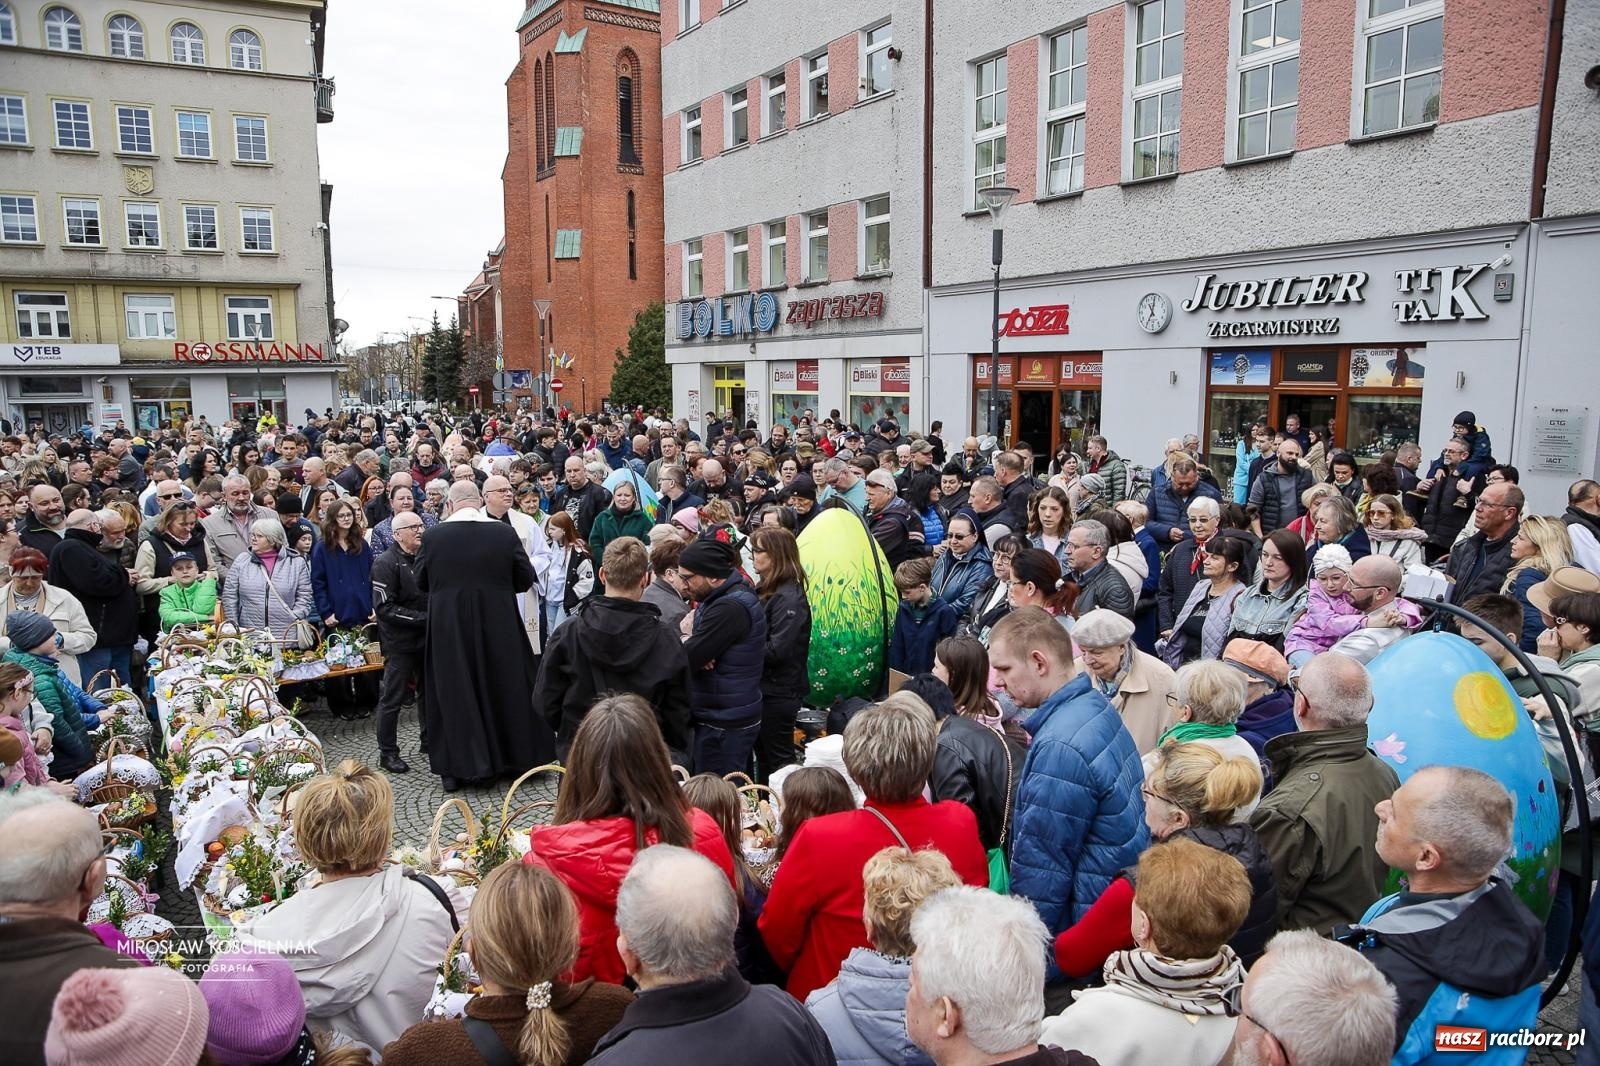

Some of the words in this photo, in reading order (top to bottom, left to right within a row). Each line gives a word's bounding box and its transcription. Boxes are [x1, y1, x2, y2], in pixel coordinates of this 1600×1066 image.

[1181, 271, 1369, 312] JUBILER
[676, 292, 779, 340] BOLKO
[786, 291, 884, 329] zaprasza
[1206, 317, 1340, 337] ZEGARMISTRZ
[35, 346, 61, 355] TEB
[174, 342, 323, 364] ROSSMANN
[780, 370, 794, 380] Bliski
[860, 369, 878, 380] Bliski
